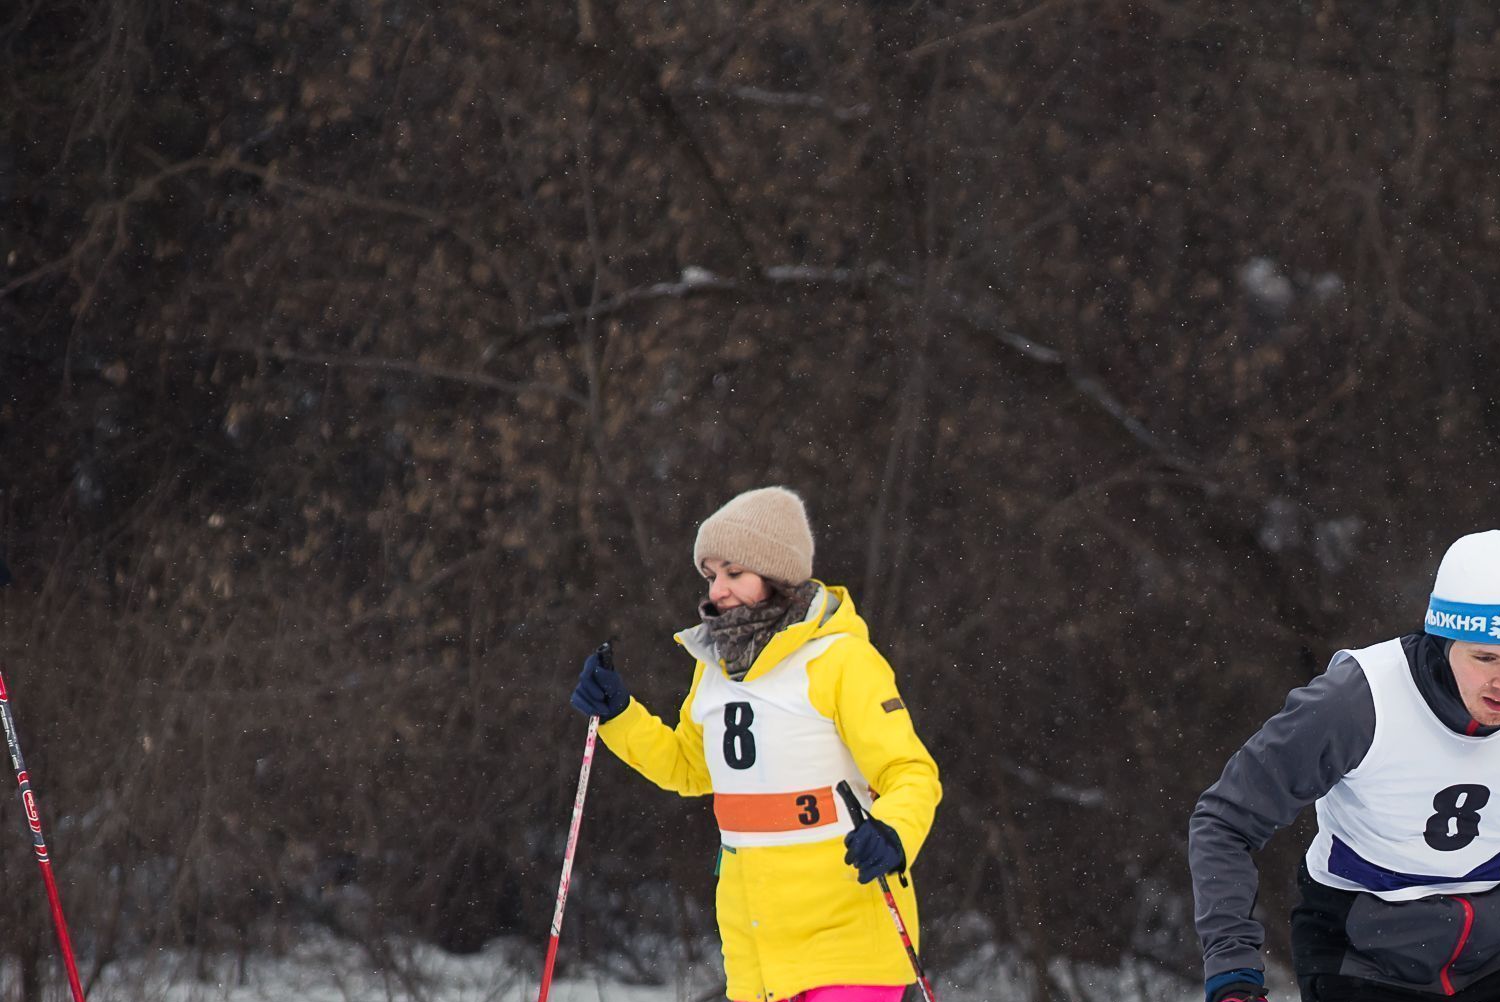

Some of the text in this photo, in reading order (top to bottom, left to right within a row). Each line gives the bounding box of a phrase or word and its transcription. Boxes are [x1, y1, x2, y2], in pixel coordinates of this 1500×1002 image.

[723, 701, 756, 770] 8
[795, 794, 820, 825] 3
[1423, 783, 1491, 852] 8
